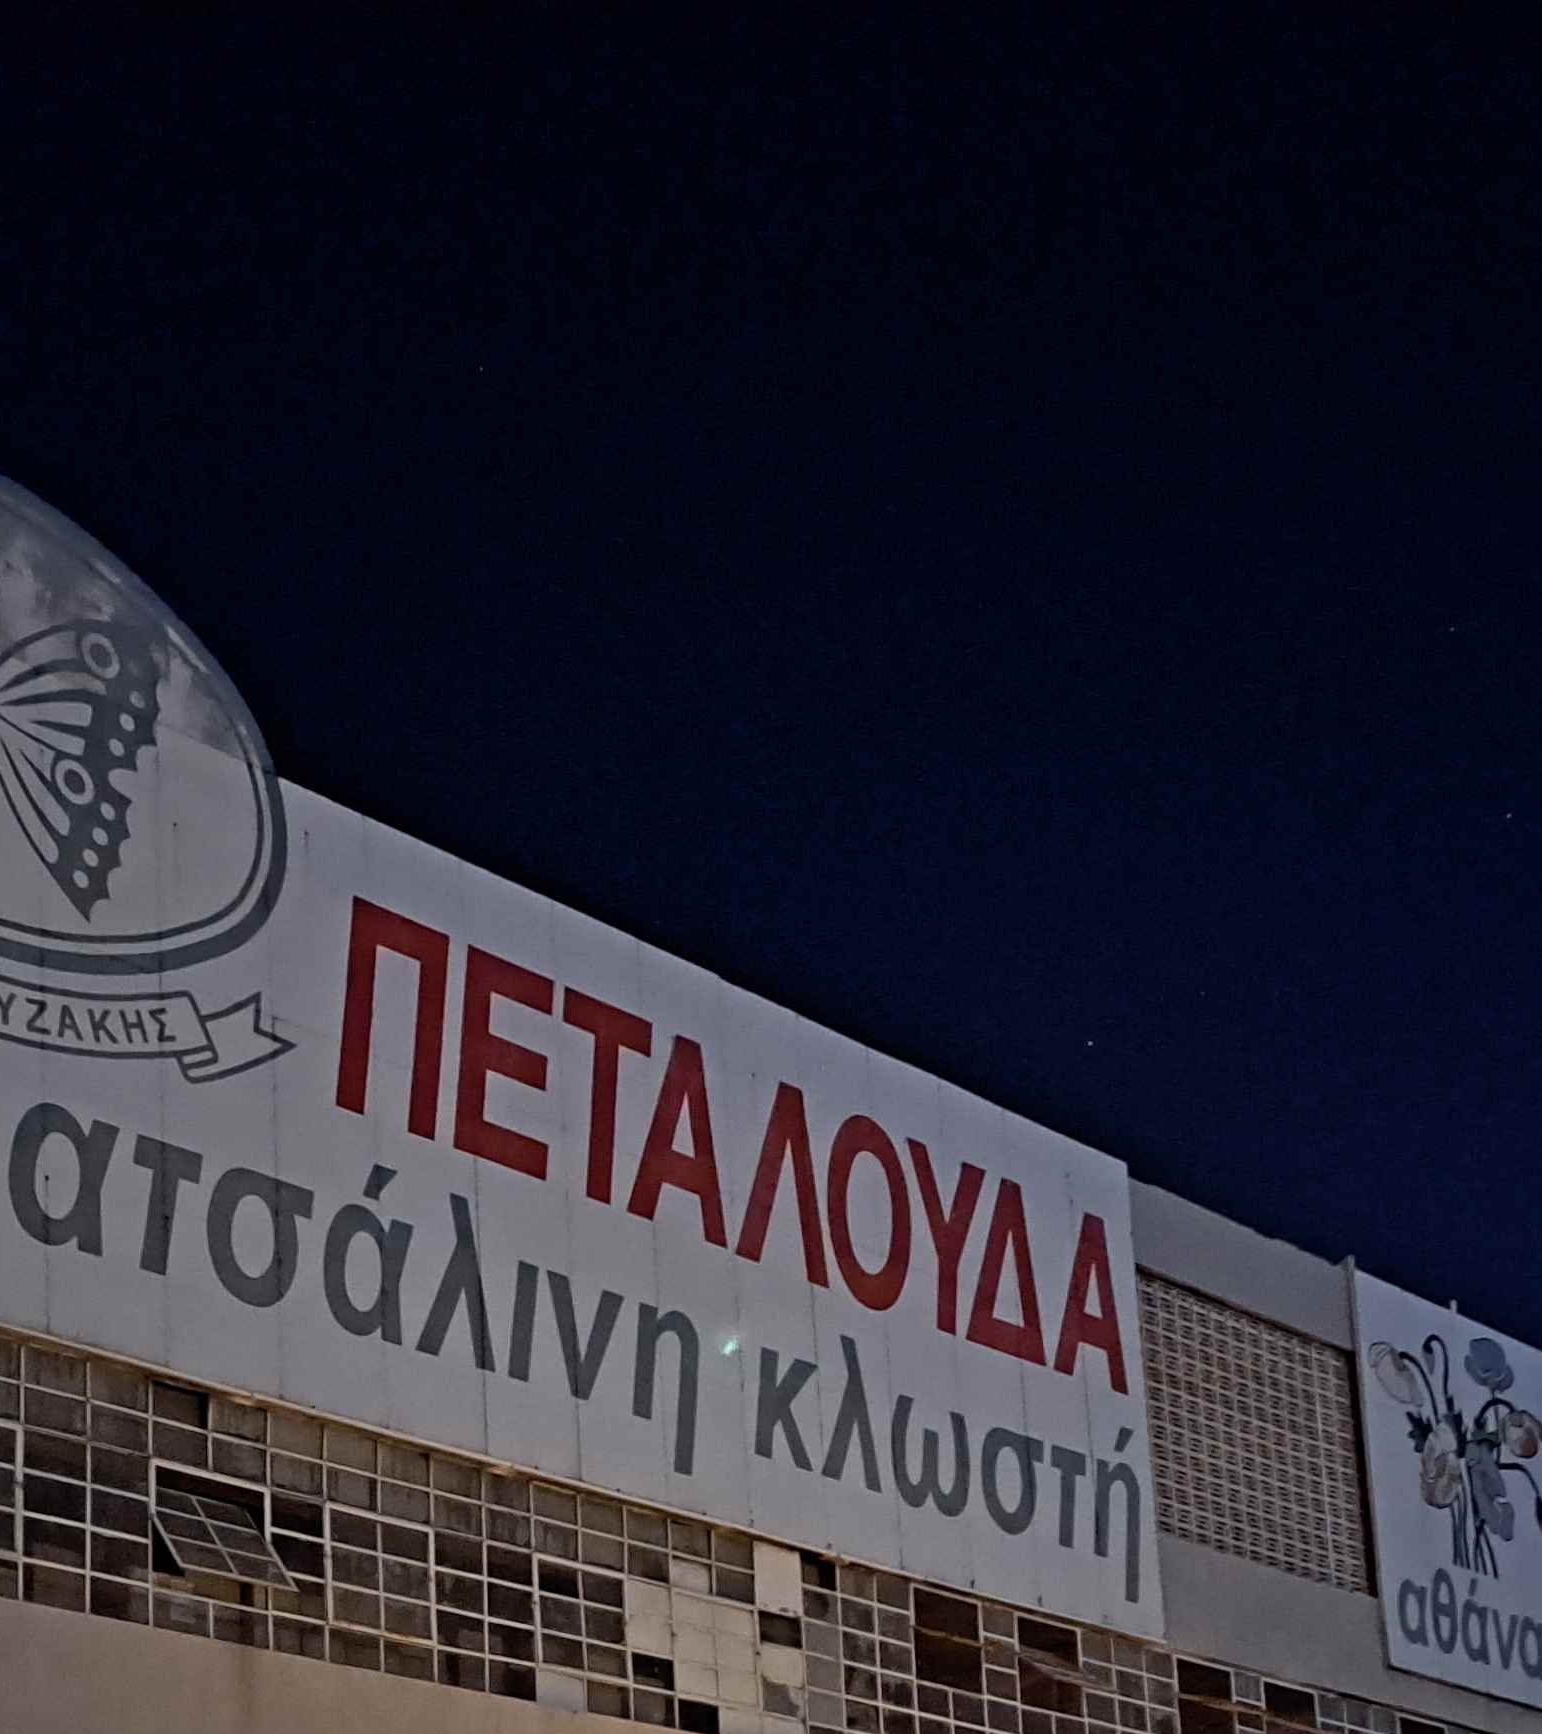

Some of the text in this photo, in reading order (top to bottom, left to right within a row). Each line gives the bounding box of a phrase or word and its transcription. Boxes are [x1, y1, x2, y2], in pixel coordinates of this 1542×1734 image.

[8, 1102, 701, 1476] ατσάλινη
[755, 1335, 1143, 1602] κλωστή
[336, 895, 1129, 1395] ΠΕΤΑΛΟΥΔΑ
